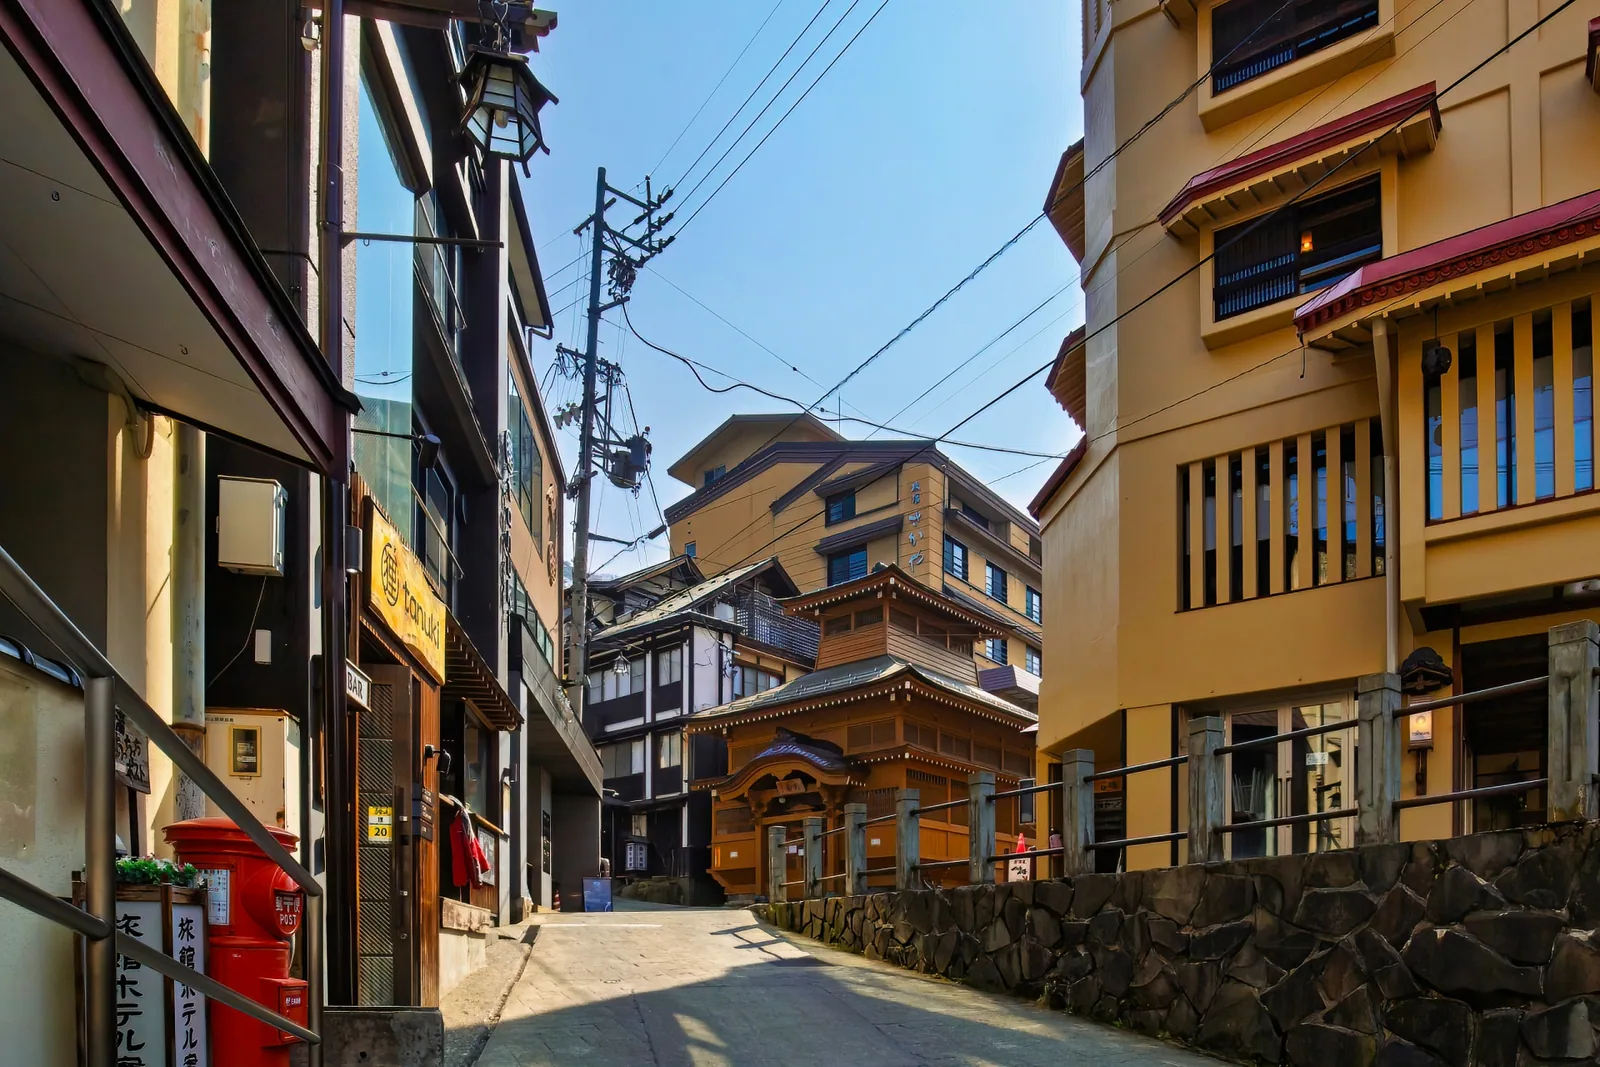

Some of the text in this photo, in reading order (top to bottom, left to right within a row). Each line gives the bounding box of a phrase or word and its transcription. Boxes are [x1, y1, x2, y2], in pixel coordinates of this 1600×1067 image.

[402, 581, 440, 649] tanuki
[347, 671, 363, 700] BAR
[374, 827, 387, 837] 20
[279, 913, 297, 926] POST
